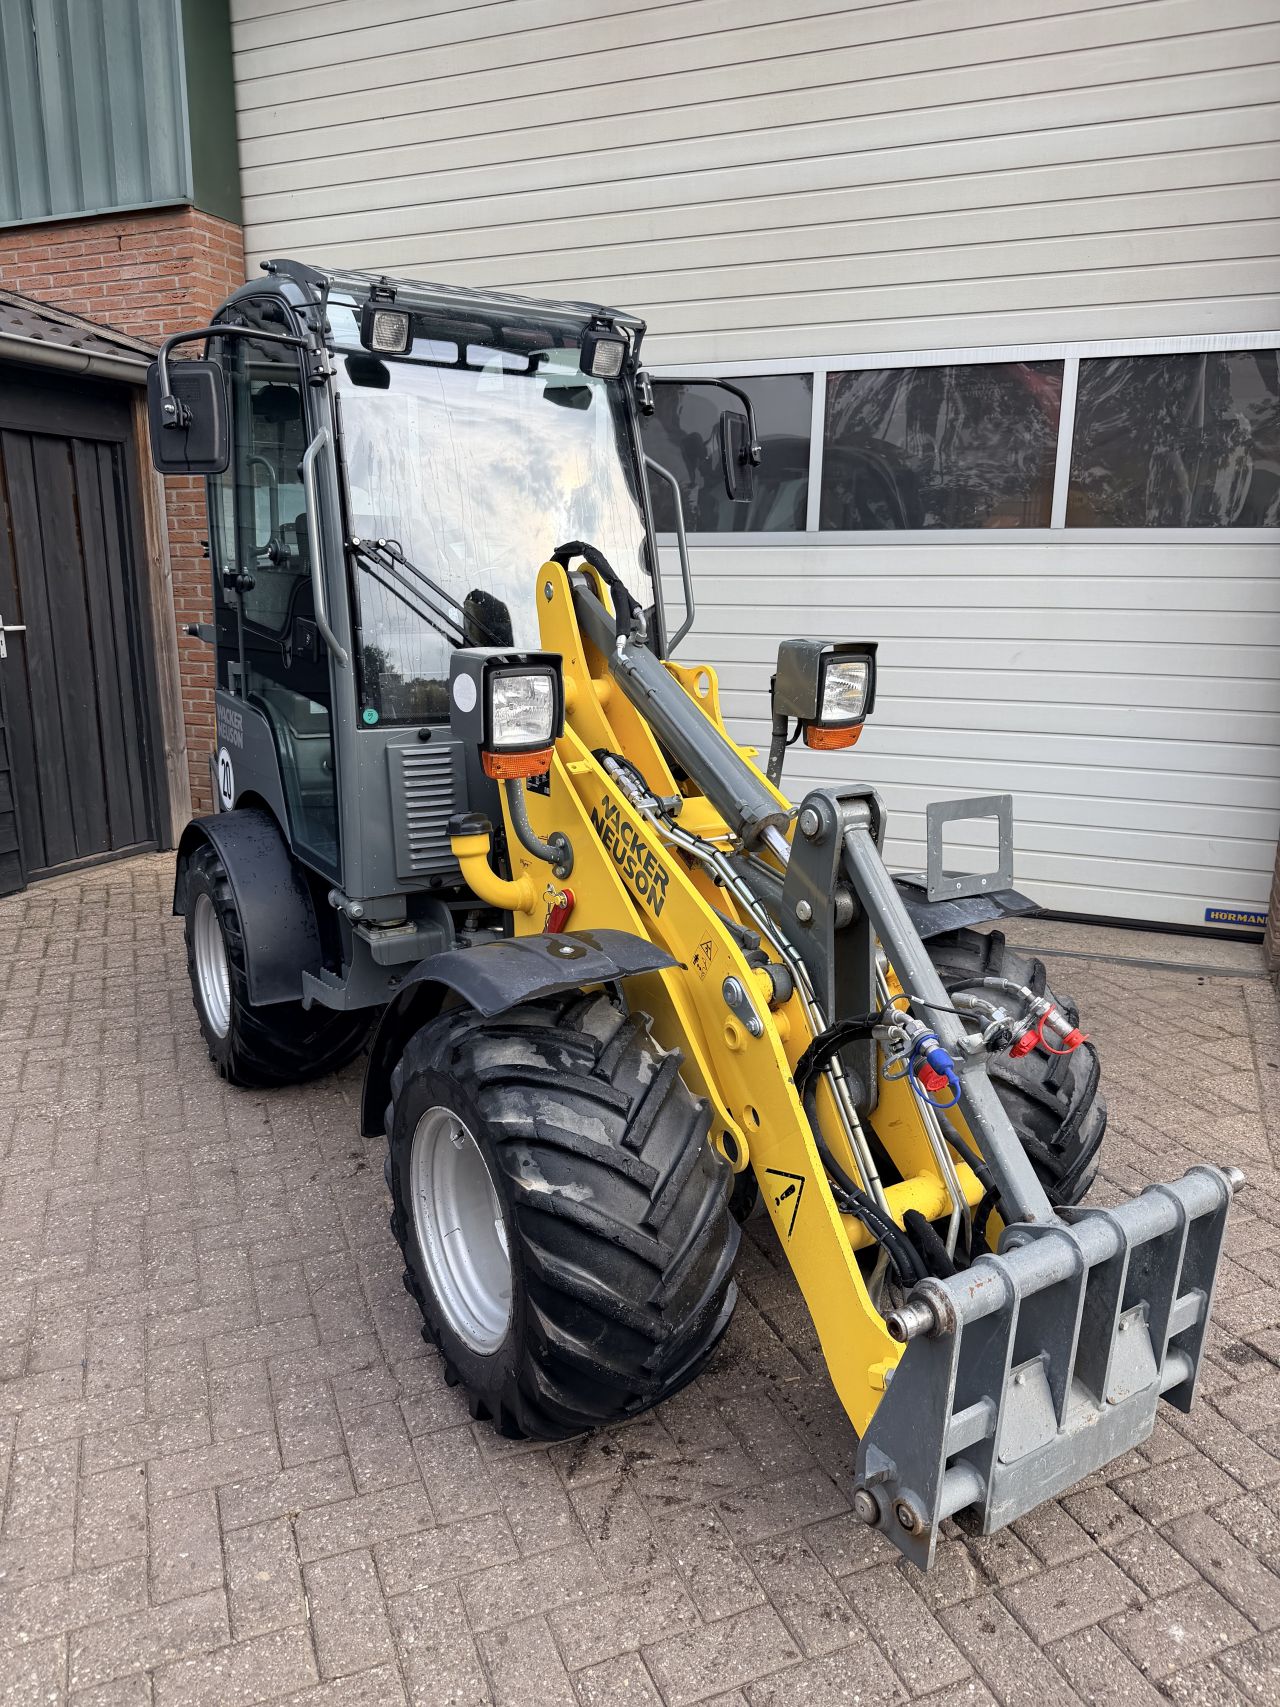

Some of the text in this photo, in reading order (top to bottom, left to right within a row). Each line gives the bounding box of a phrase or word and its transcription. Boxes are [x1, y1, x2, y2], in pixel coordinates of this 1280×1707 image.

[218, 720, 243, 749] NEUSON
[221, 758, 231, 800] 20
[590, 807, 664, 917] NEUSON
